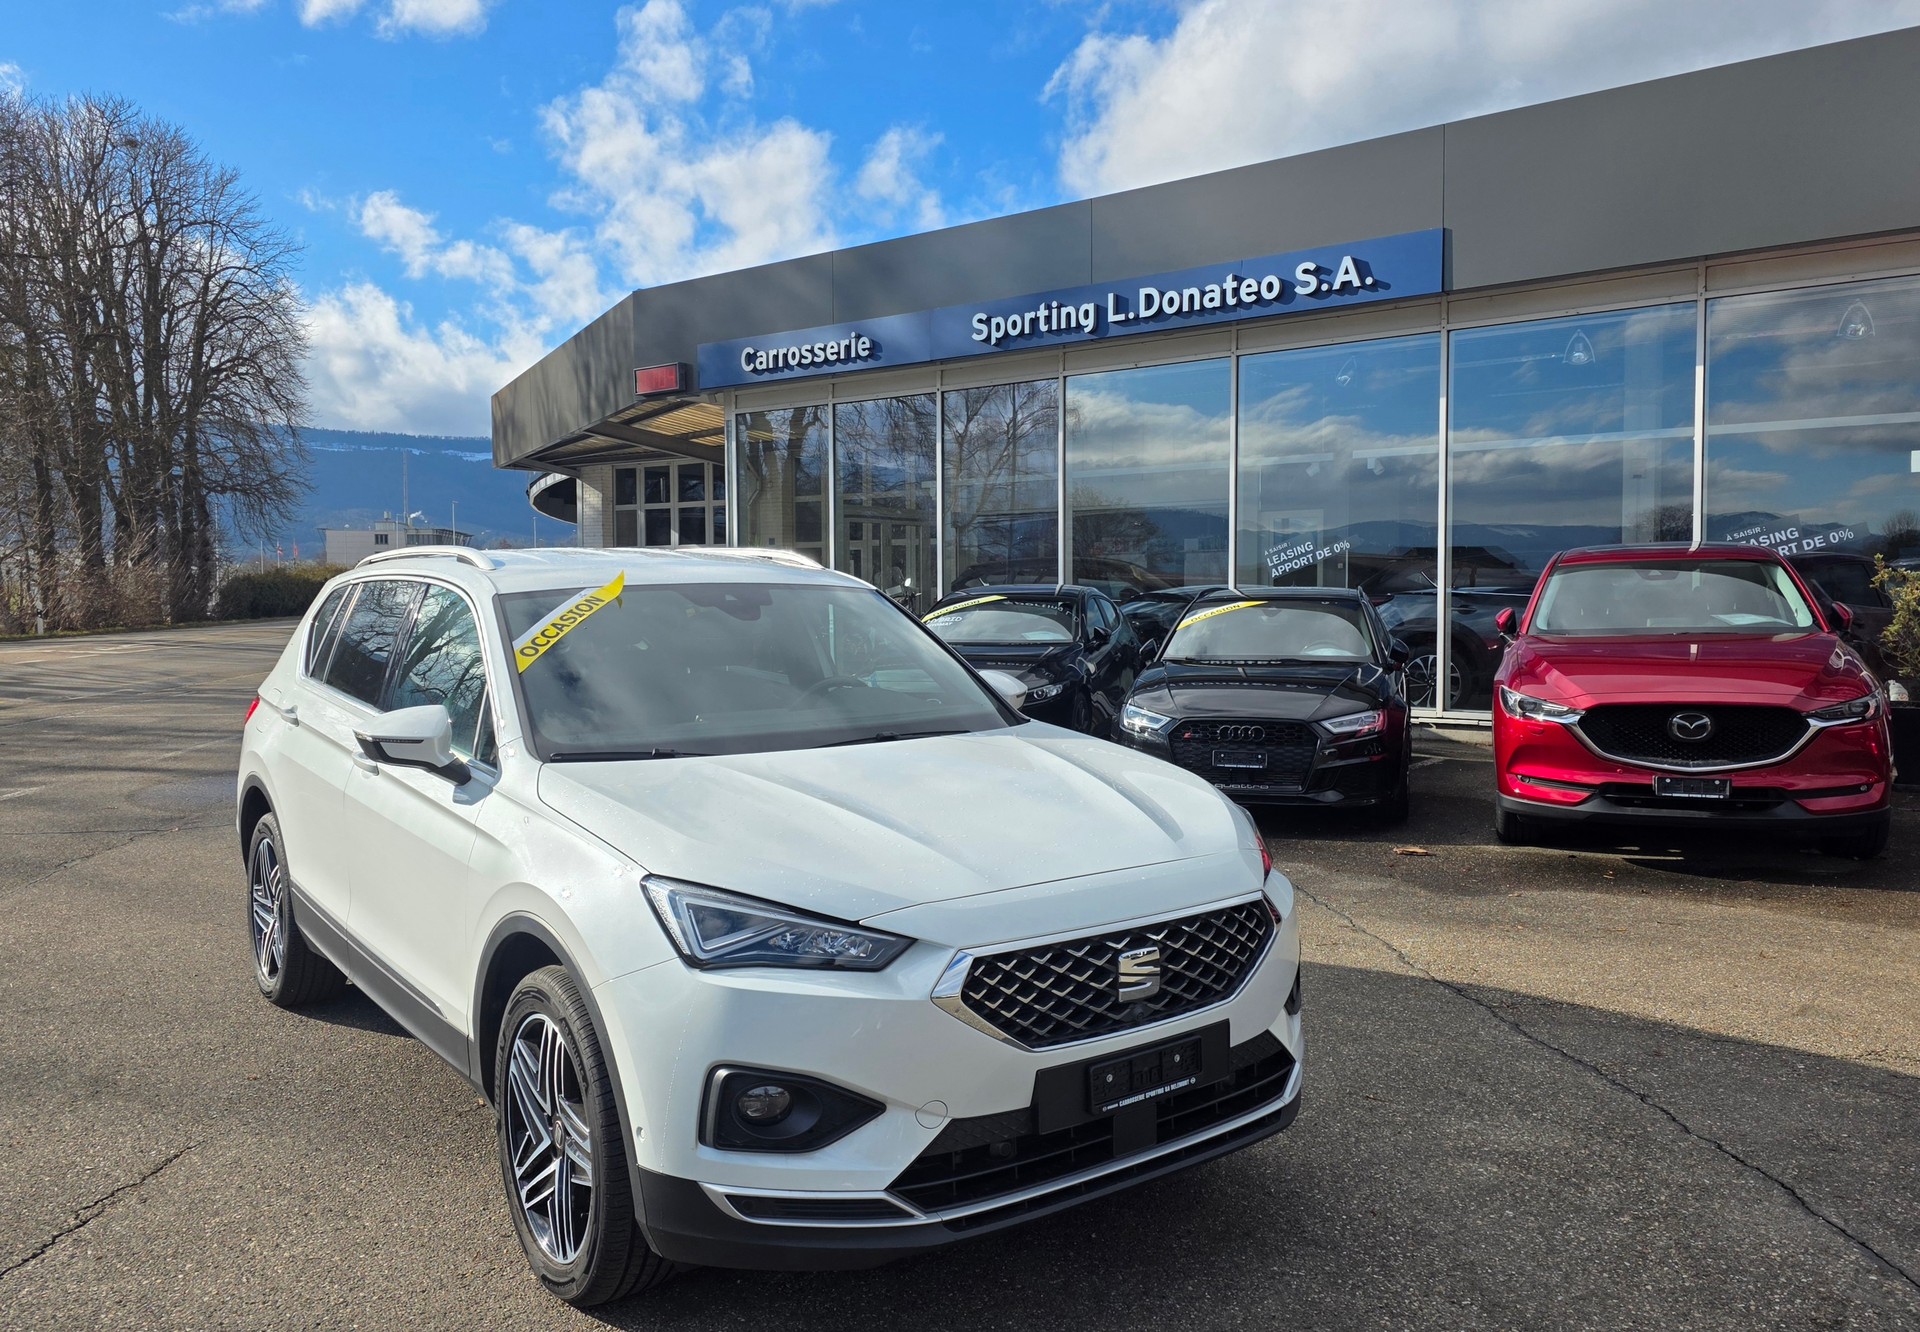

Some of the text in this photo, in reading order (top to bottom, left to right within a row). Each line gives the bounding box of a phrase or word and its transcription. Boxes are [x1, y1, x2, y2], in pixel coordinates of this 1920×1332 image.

[971, 255, 1375, 346] Sporting L.Donateo S.A.
[741, 331, 871, 372] Carrosserie
[1733, 526, 1762, 540] SAISIR
[1740, 527, 1799, 547] ASING
[1802, 535, 1826, 551] DE
[1829, 528, 1854, 544] 0%
[1266, 541, 1314, 567] LEASING
[1269, 542, 1288, 554] SAISIR
[1271, 540, 1351, 578] APPORT DE 0%
[1190, 604, 1241, 623] OCCASION
[519, 595, 606, 658] OCCASION
